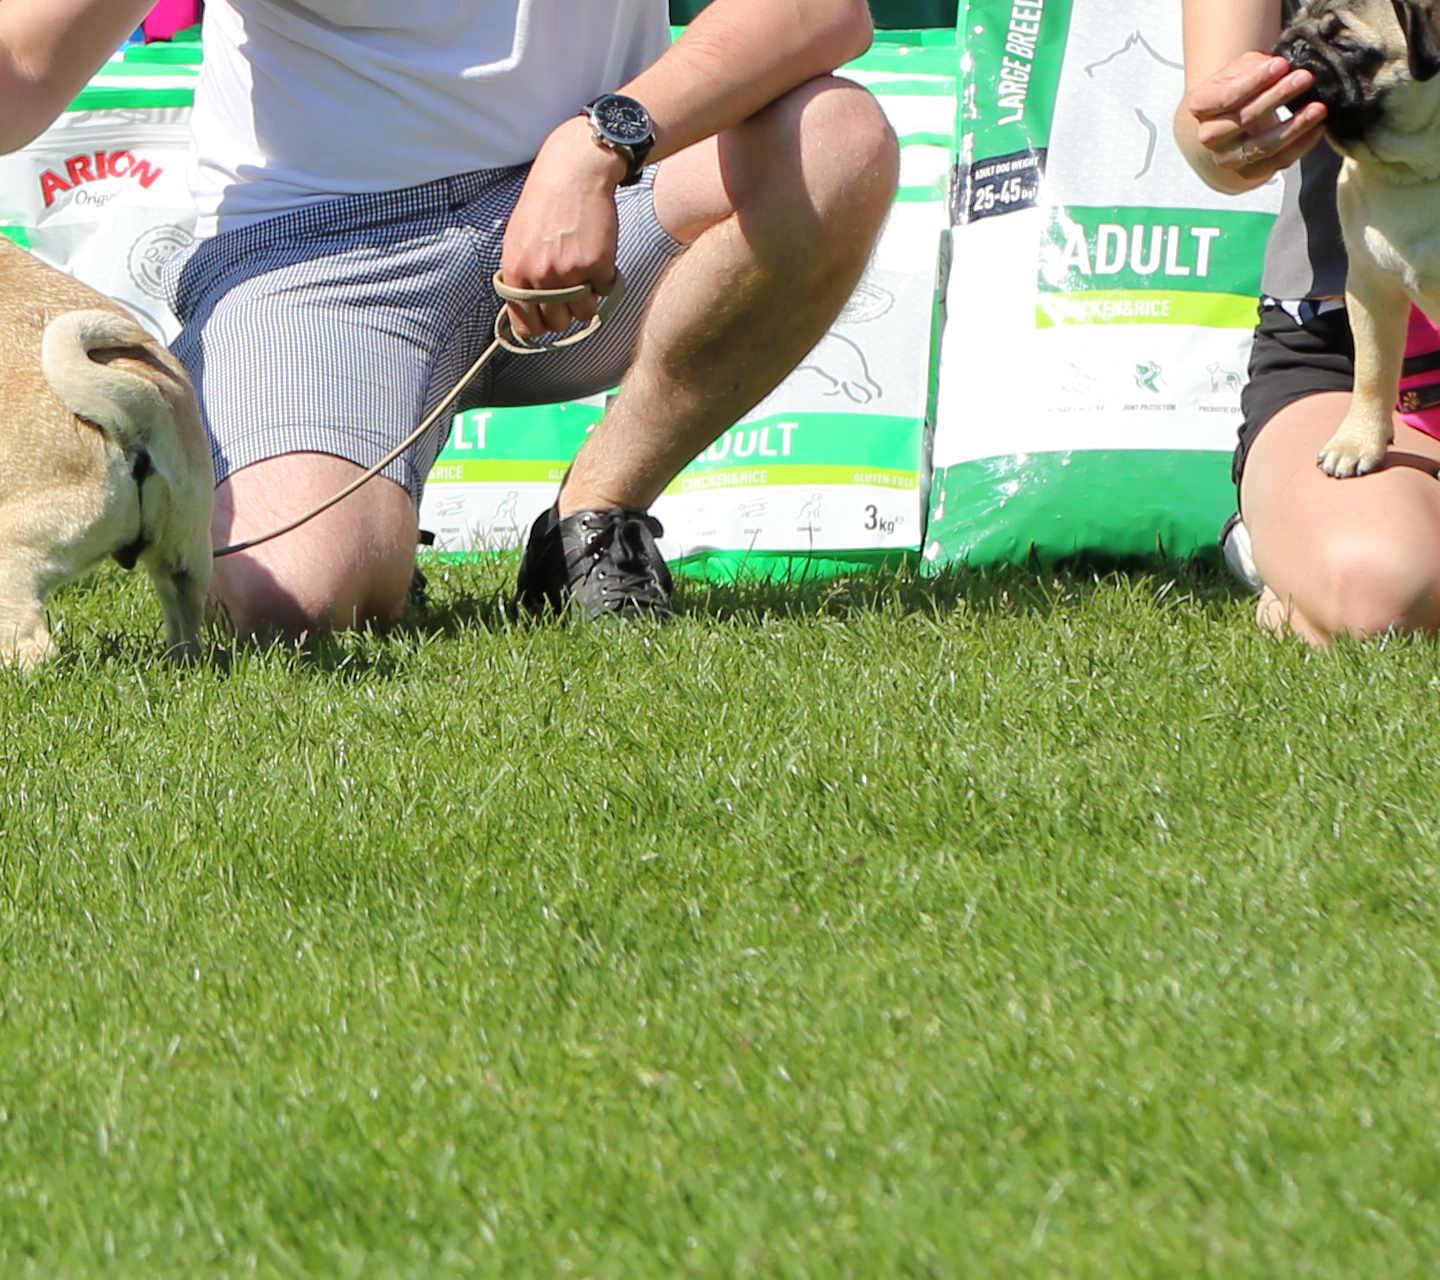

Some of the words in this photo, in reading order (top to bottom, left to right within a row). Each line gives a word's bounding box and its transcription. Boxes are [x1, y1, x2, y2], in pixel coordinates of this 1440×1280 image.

[997, 56, 1031, 126] LARGE
[39, 149, 164, 208] ARION
[973, 177, 1022, 212] 25-45
[975, 164, 995, 181] ADULT
[996, 161, 1011, 175] DOG
[1011, 156, 1039, 171] WEIGHT
[1062, 223, 1220, 277] ADULT
